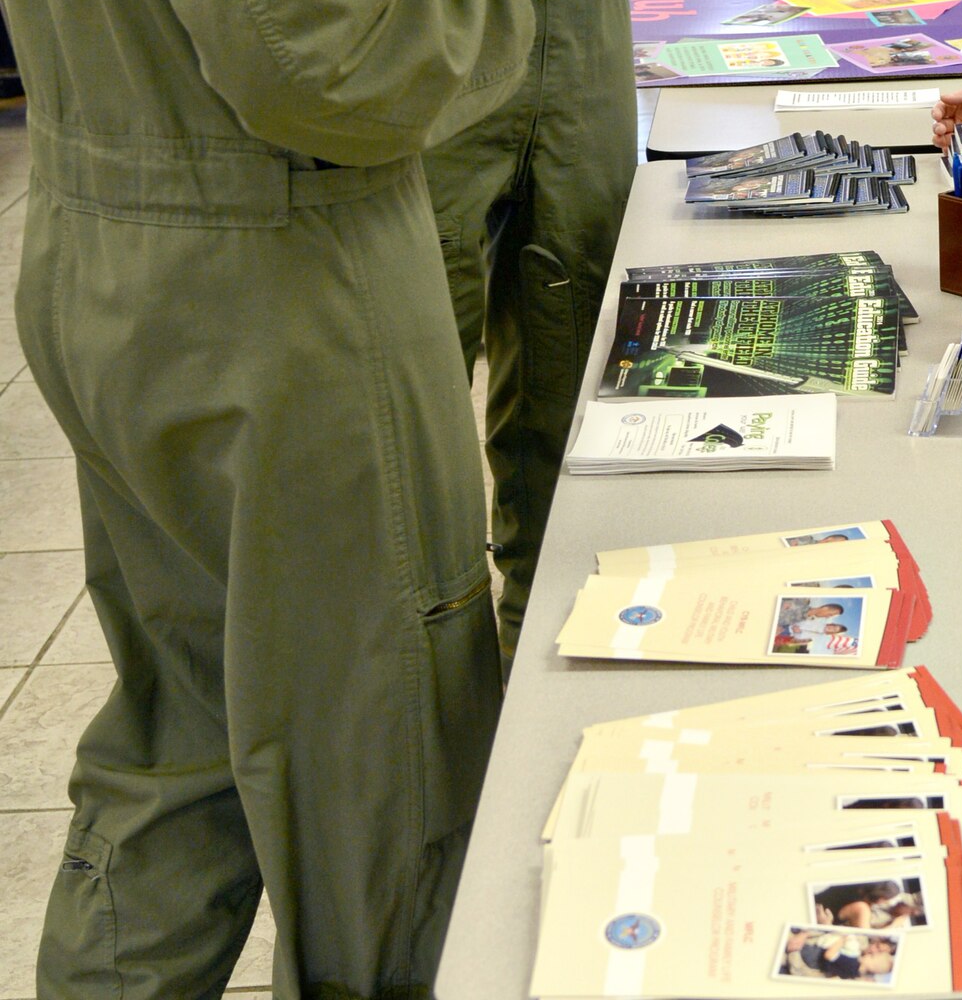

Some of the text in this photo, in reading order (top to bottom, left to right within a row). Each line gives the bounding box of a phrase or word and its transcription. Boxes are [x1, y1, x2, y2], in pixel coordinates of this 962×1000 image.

[740, 301, 760, 322] THE
[755, 301, 779, 357] AT HOME IN
[854, 299, 883, 357] Education
[734, 338, 753, 366] FIELD
[851, 359, 878, 391] Guide
[743, 412, 773, 439] Paying
